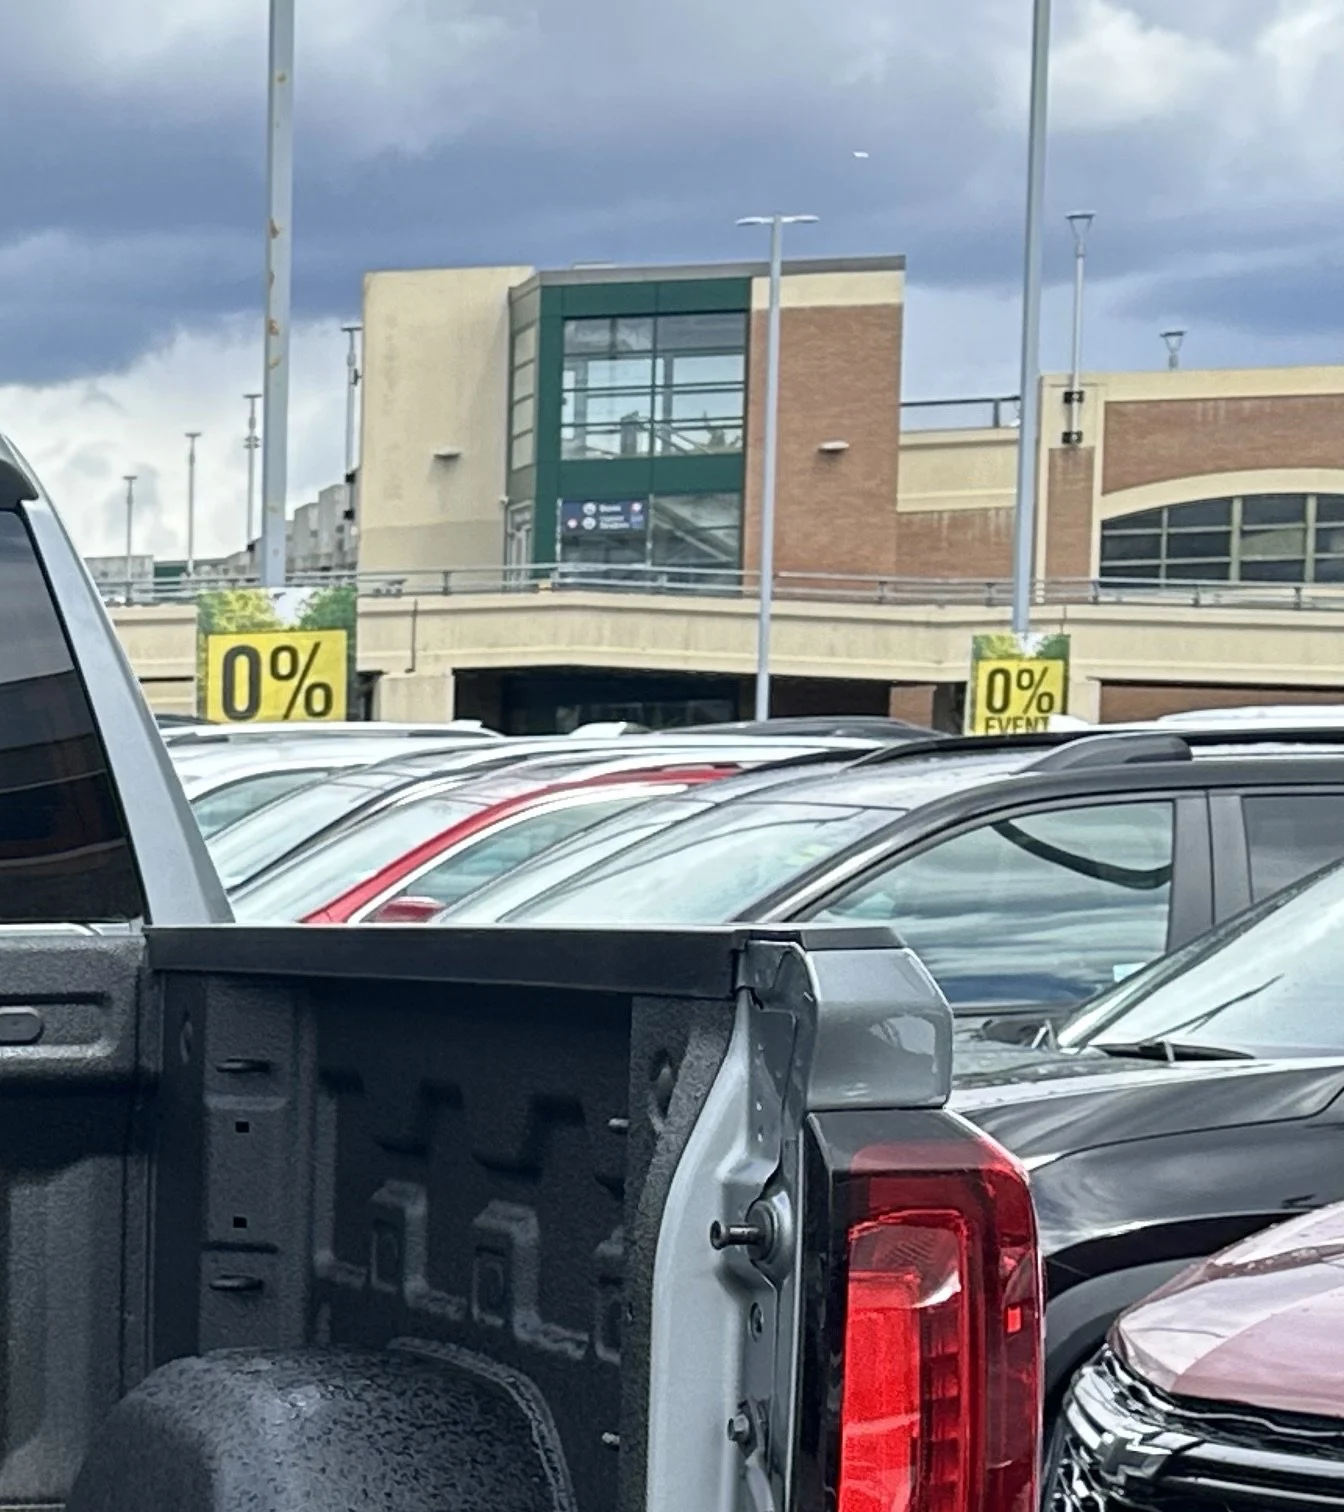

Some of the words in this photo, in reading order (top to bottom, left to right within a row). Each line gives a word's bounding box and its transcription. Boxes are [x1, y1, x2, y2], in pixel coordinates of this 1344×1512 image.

[222, 641, 333, 721] 0%
[986, 666, 1054, 714] 0%
[985, 716, 1049, 735] EVENT
